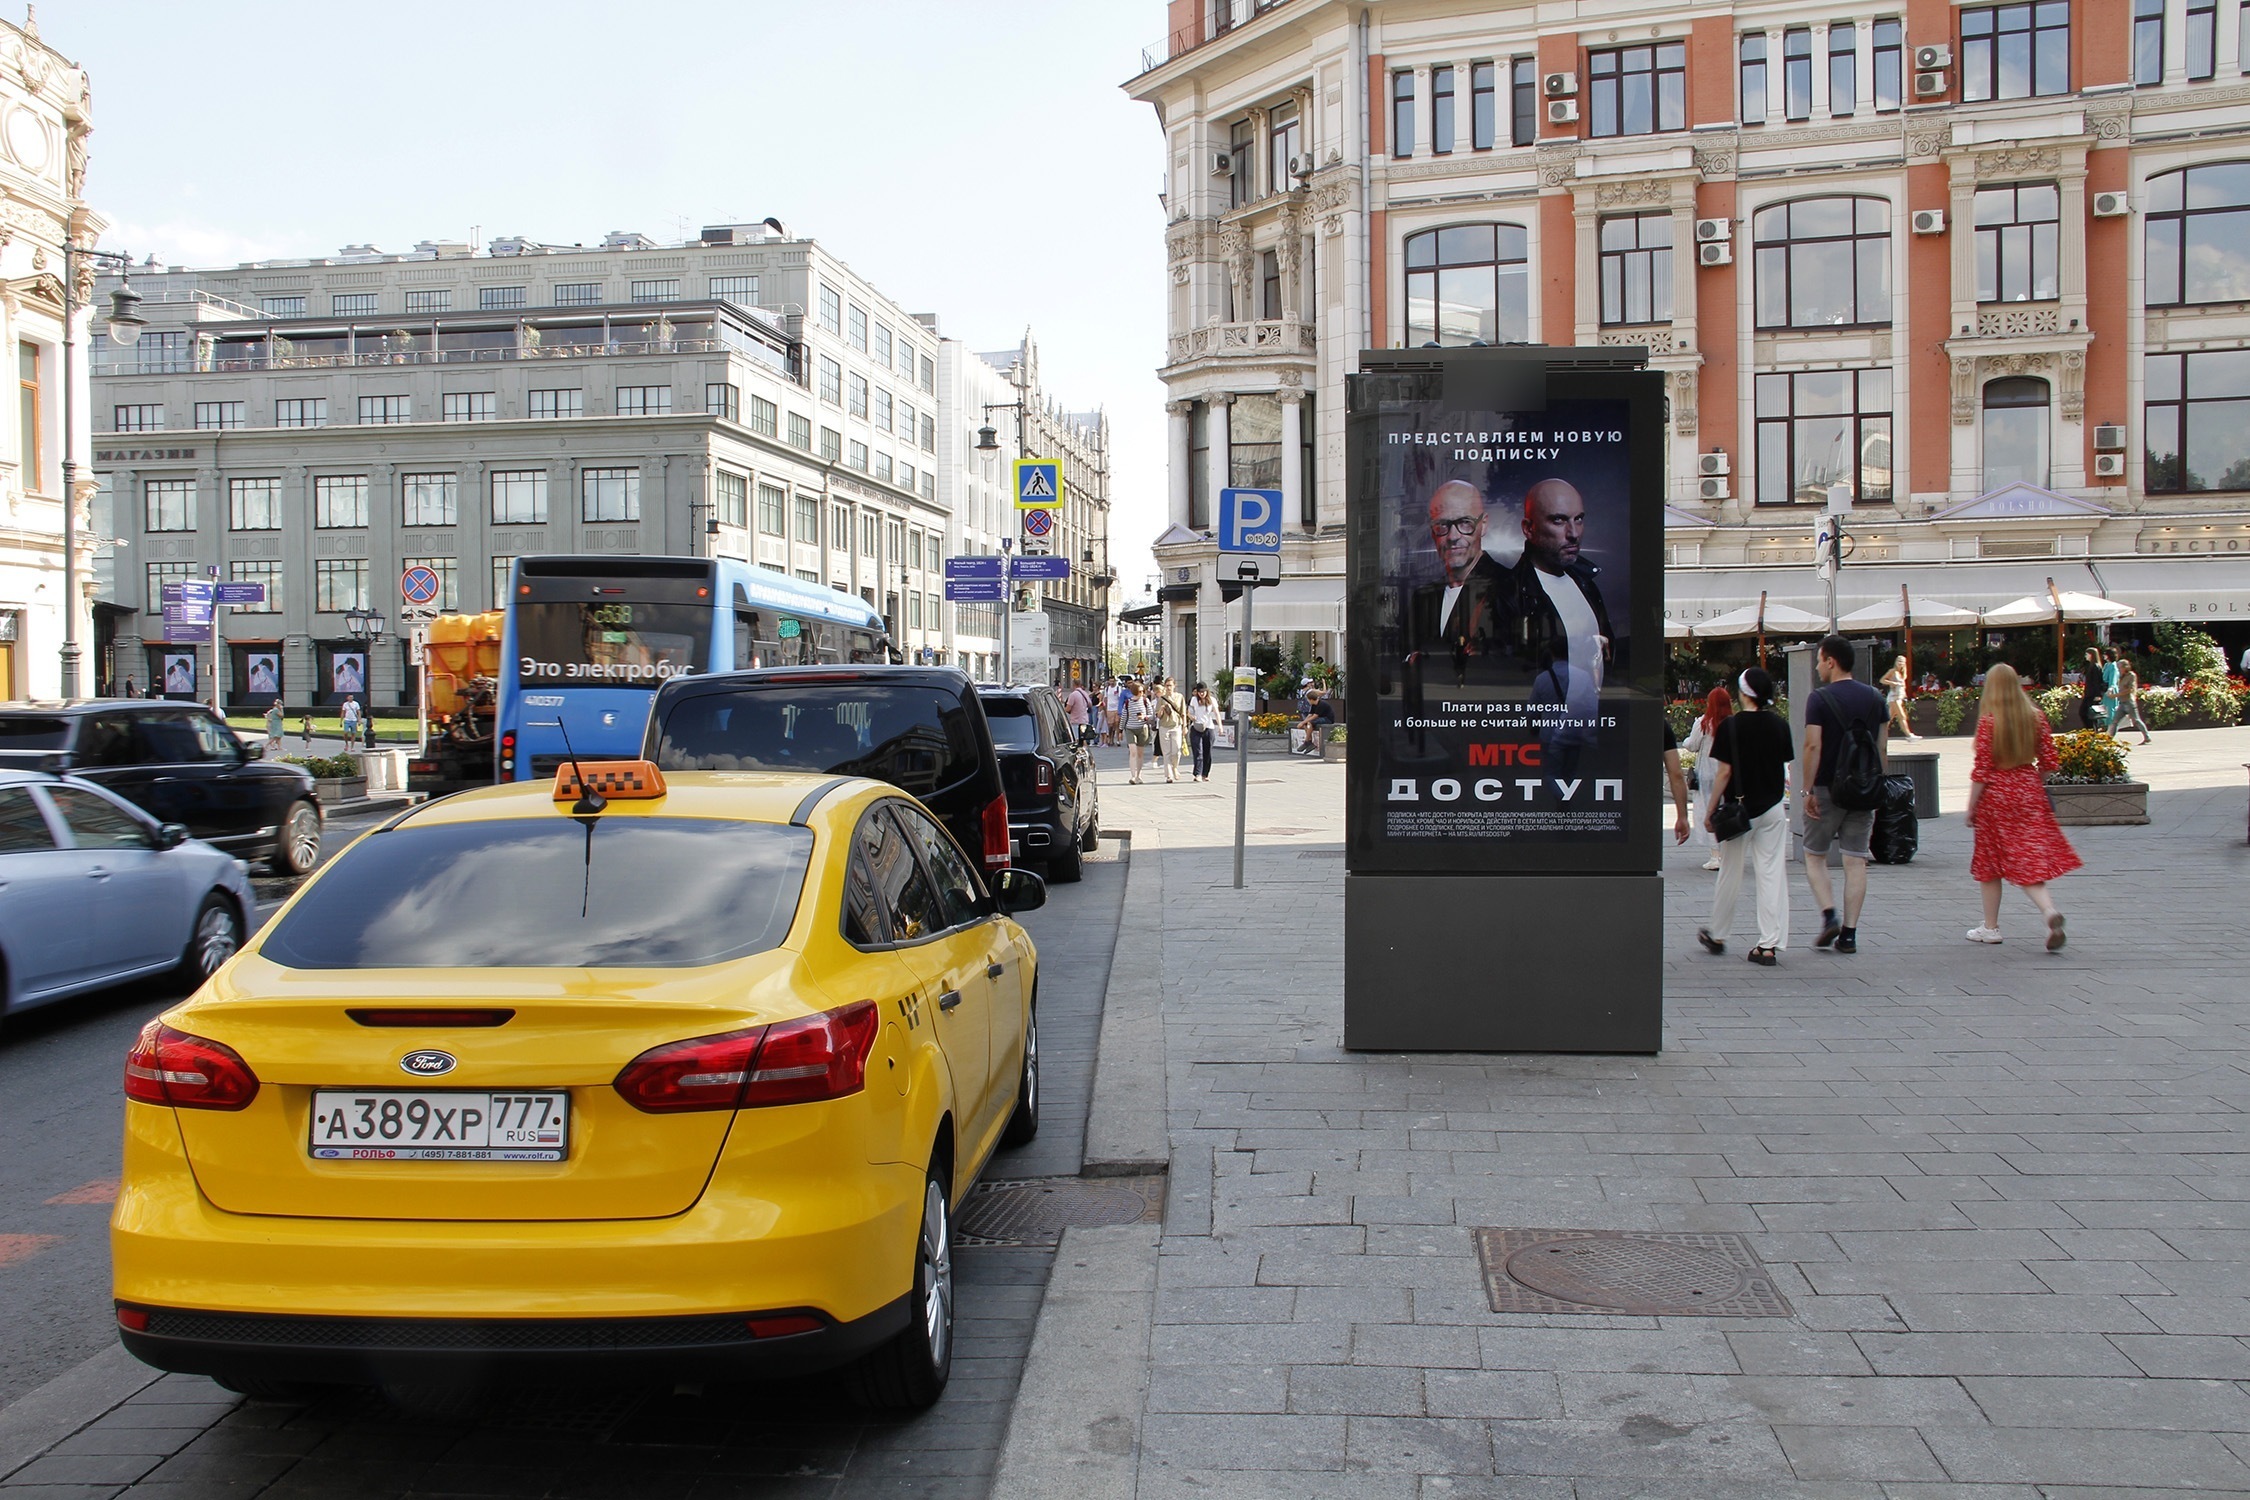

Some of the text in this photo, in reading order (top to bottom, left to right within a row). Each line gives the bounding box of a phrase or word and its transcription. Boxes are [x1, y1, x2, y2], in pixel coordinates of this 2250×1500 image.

[1388, 430, 1623, 445] ПРЕДСТАВЛЯЕМ НОВУЮ
[96, 448, 196, 461] МАГАЗИН
[1454, 448, 1561, 461] ПОДПИСКУ
[1989, 500, 2054, 512] BOLSHOI
[1266, 535, 1277, 544] 20
[2151, 539, 2250, 553] РЕСТО
[520, 657, 561, 677] Это
[1442, 701, 1569, 714] Плати раз в месяц
[1394, 716, 1616, 730] и больше не считай минуты и ГБ
[1468, 743, 1542, 766] МТС
[1387, 778, 1623, 801] ДОСТУП
[412, 1055, 444, 1070] Ford
[493, 1096, 554, 1128] 777
[506, 1130, 536, 1142] RUS
[352, 1149, 554, 1160] РОЛЬФ (495) 7-881-881 www.rolf.ru
